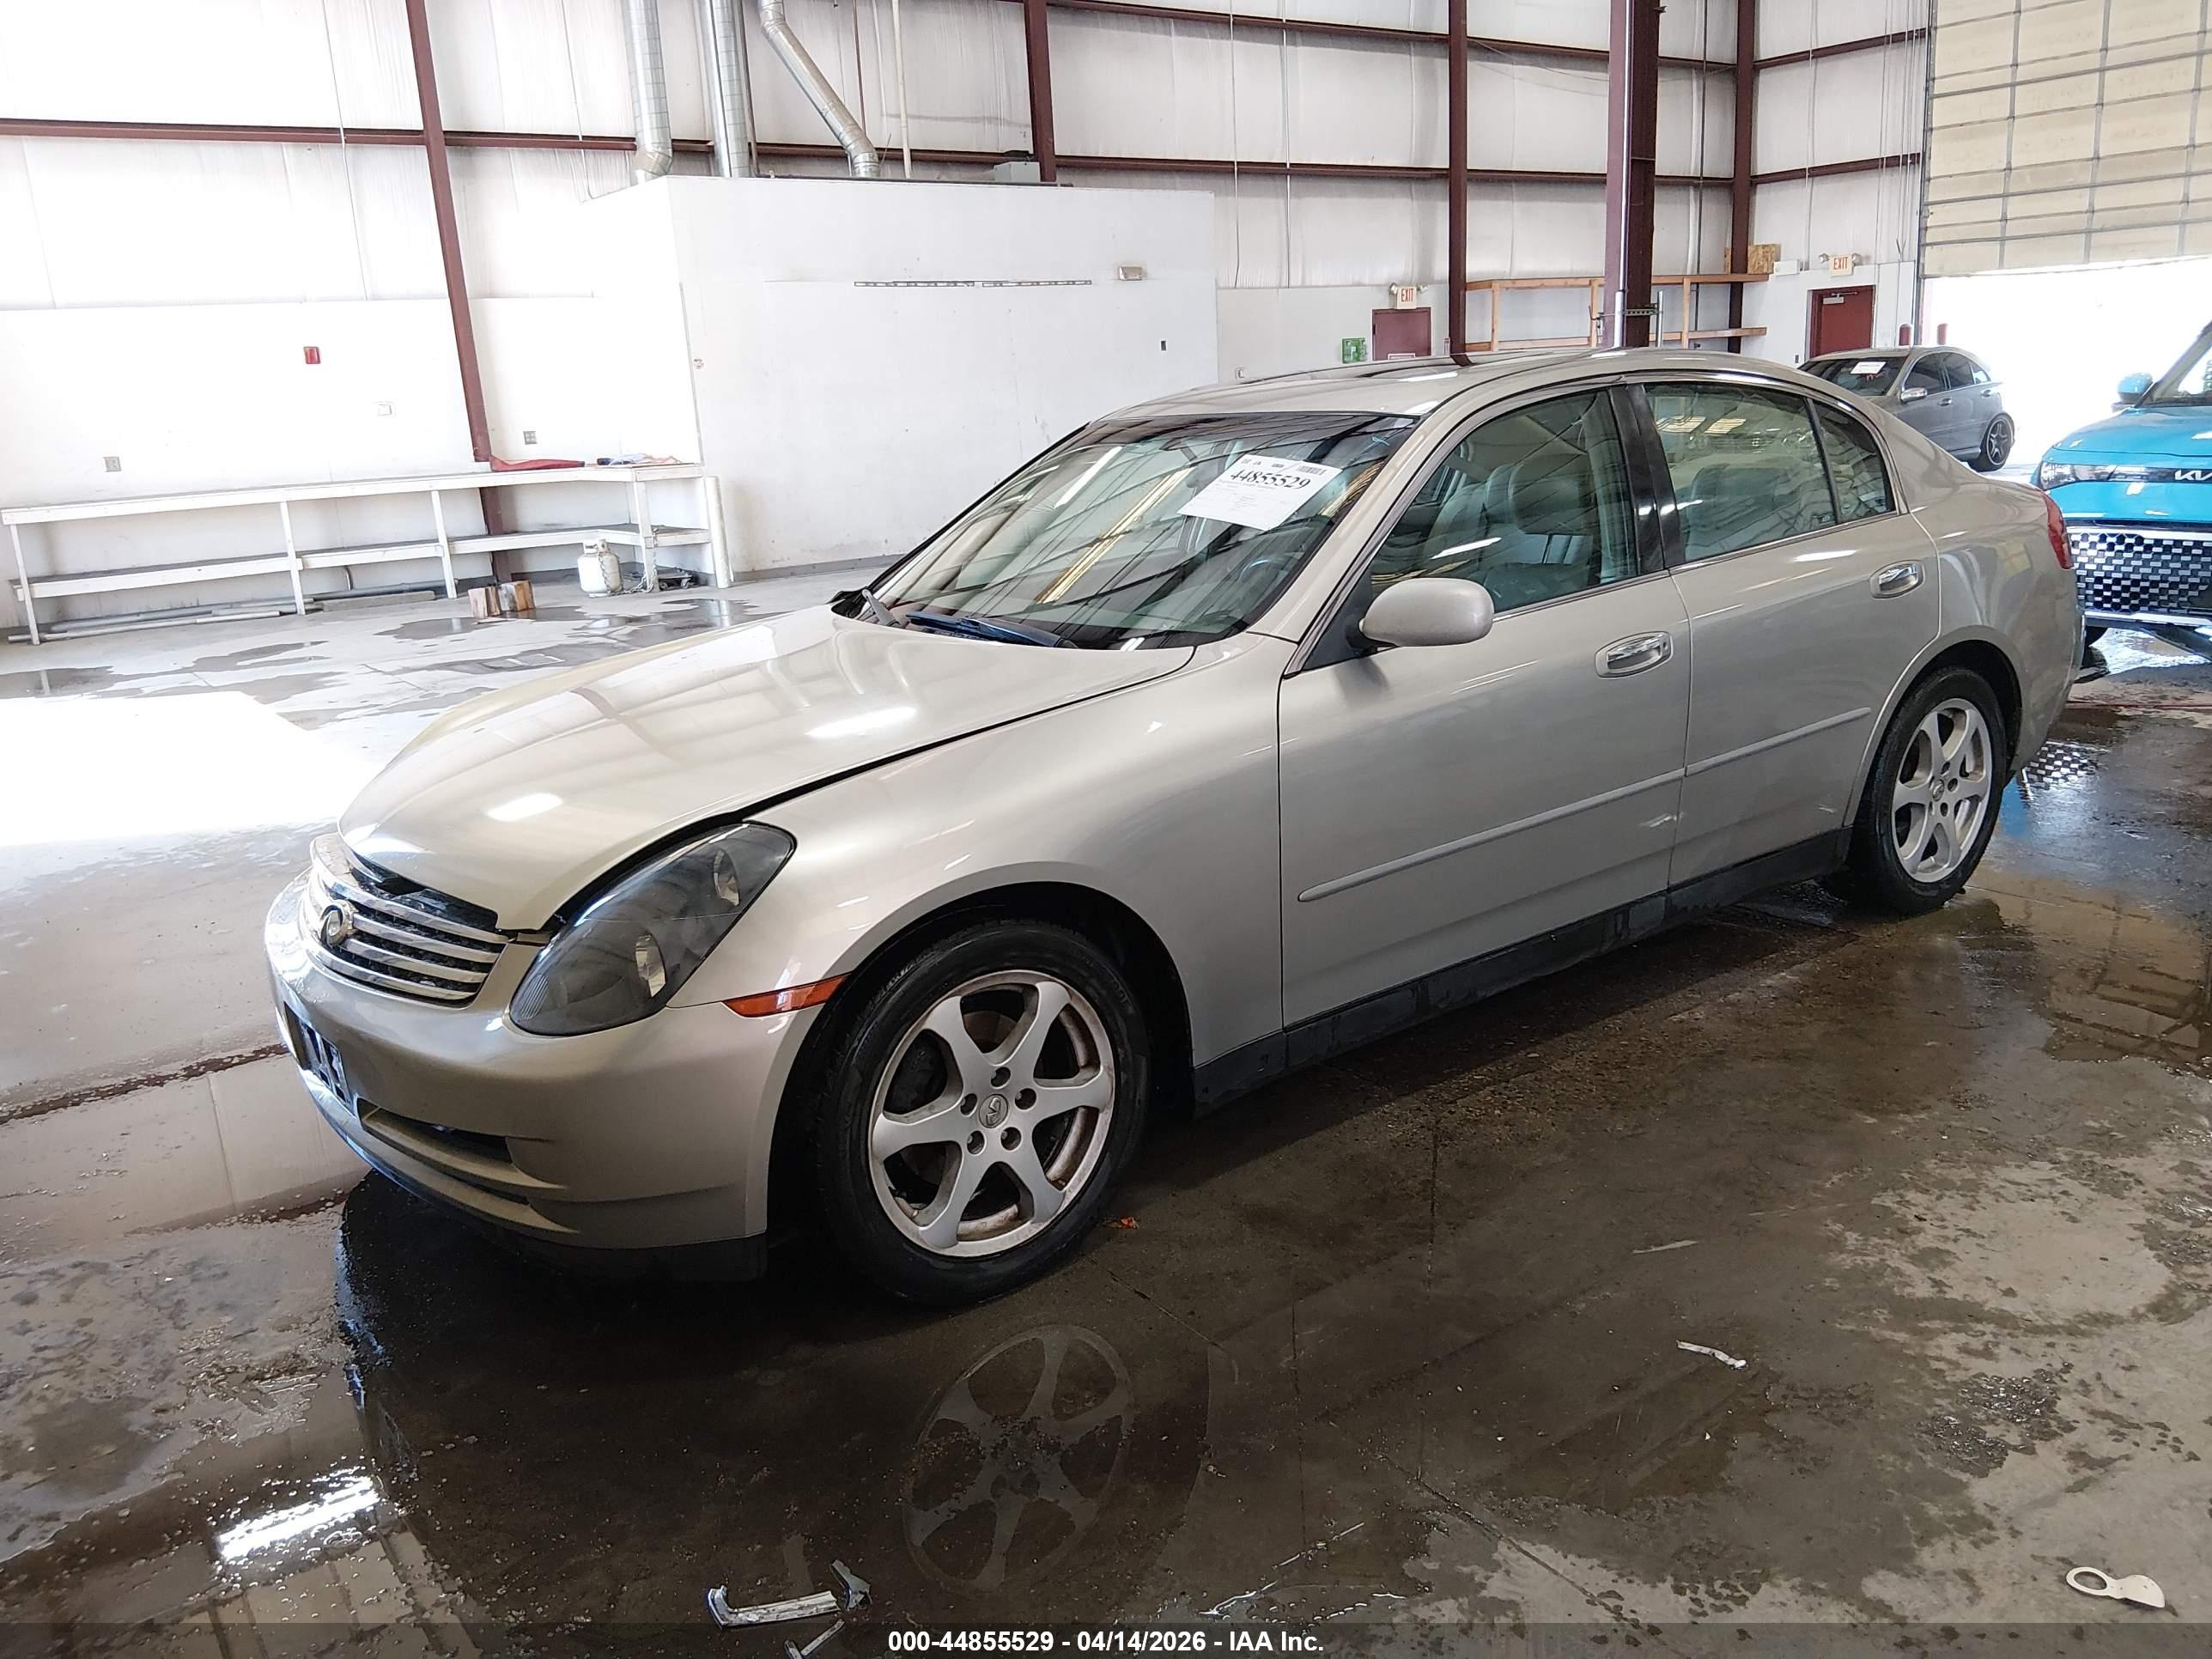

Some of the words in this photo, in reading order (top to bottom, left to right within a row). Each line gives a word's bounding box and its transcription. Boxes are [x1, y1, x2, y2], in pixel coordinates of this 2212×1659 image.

[1833, 256, 1849, 270] EXIT
[1401, 288, 1414, 302] EXIT
[1230, 469, 1311, 489] 44855529
